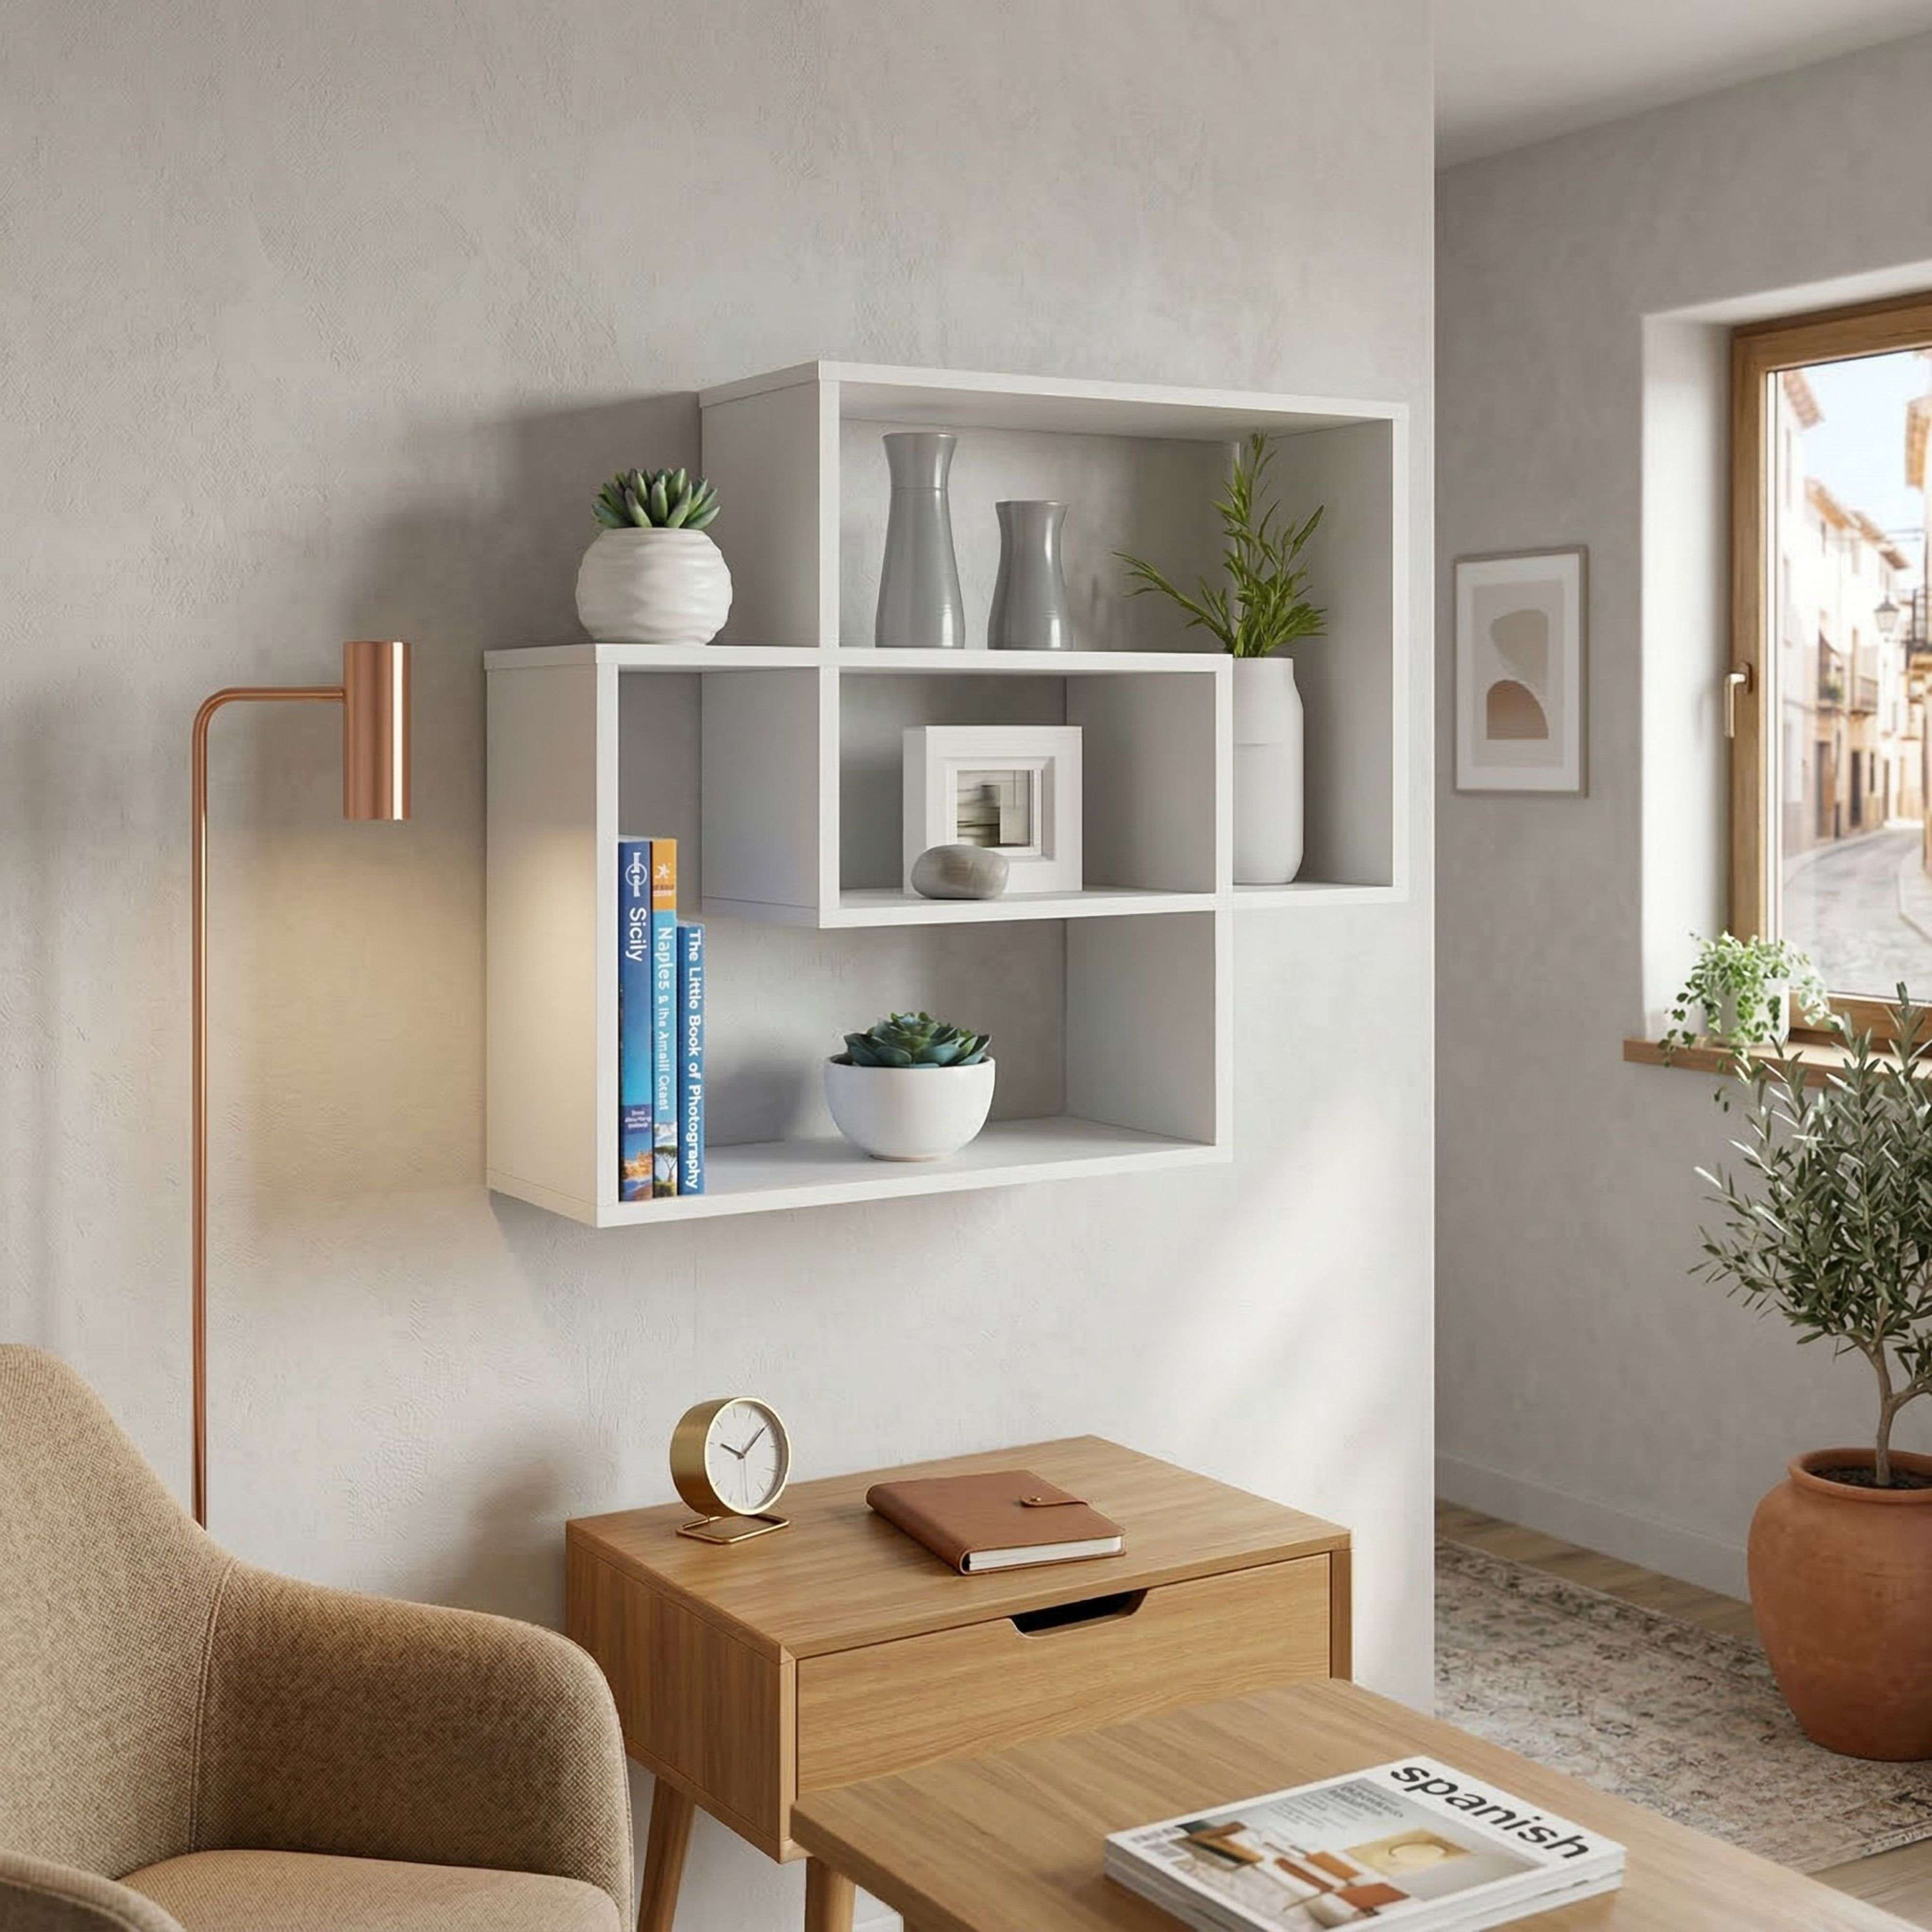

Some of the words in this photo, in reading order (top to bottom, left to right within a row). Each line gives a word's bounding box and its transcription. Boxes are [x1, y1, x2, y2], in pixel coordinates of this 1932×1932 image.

[626, 907, 647, 962] Sicily
[654, 927, 673, 990] Naples
[689, 929, 701, 962] The
[688, 1015, 702, 1056] Book
[688, 1064, 702, 1079] of
[685, 1084, 702, 1189] Photography
[1391, 1766, 1589, 1859] spanish
